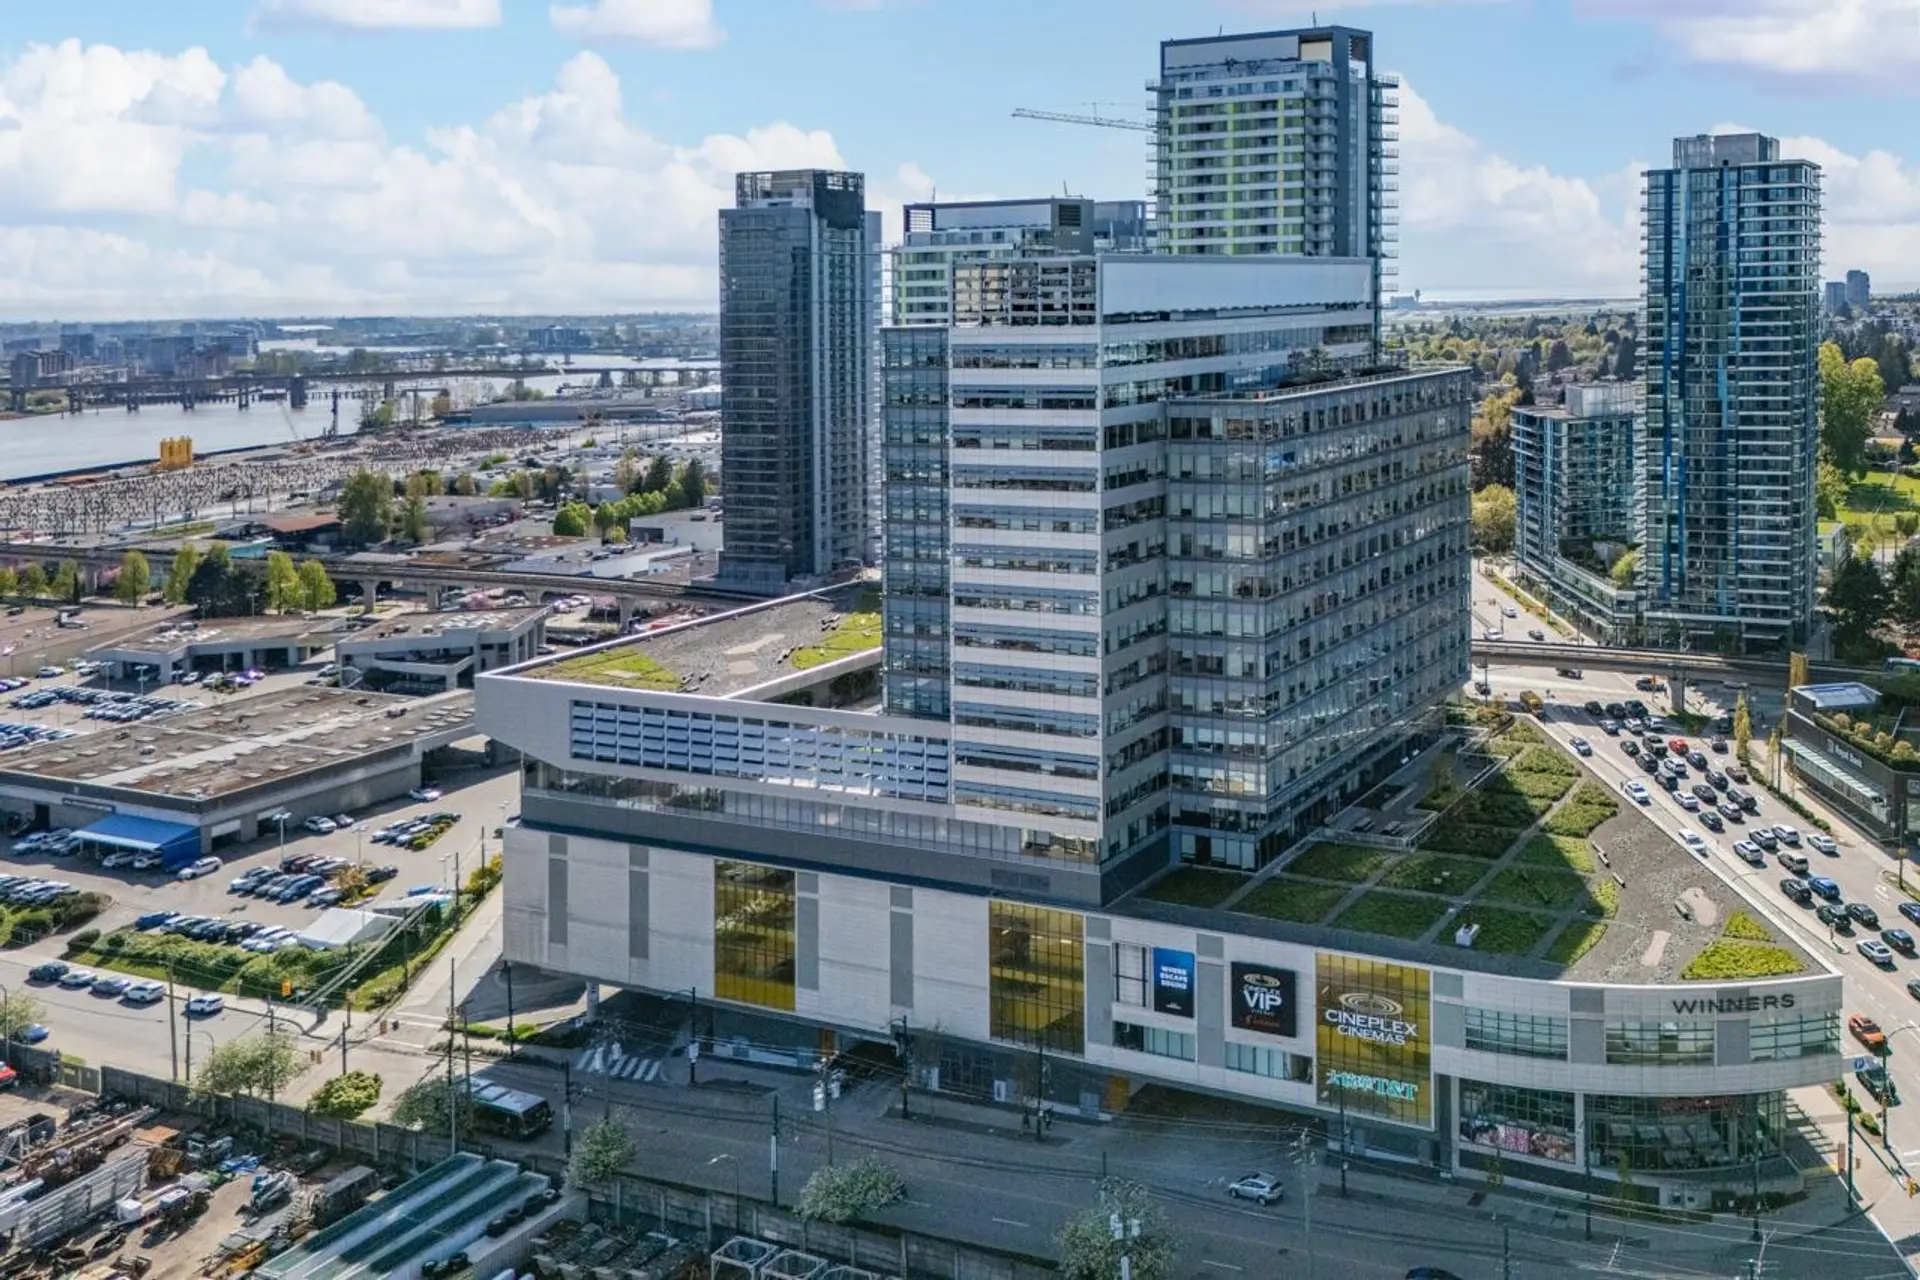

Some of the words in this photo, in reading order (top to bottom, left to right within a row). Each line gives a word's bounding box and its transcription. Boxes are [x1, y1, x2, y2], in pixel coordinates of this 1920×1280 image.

[1243, 989, 1282, 1011] VIP
[1673, 993, 1795, 1014] WINNERS
[1325, 1009, 1418, 1037] CINEPLEX
[1337, 1024, 1406, 1046] CINEMAS
